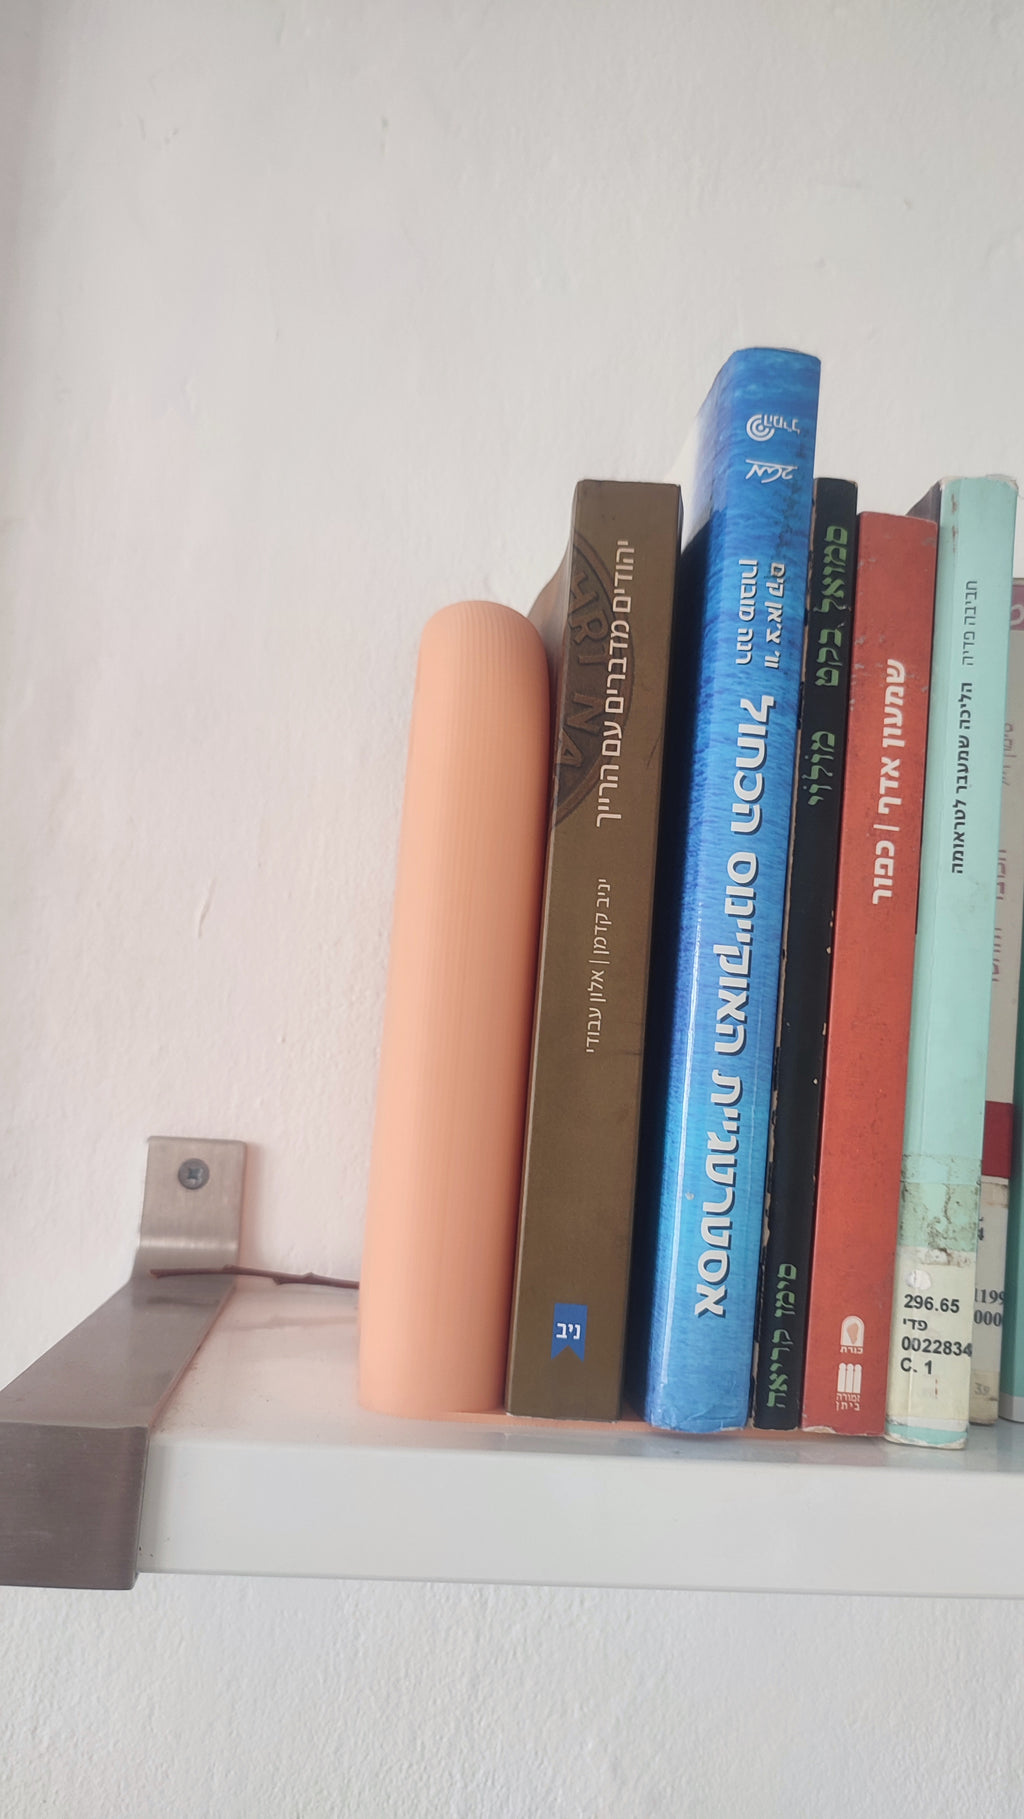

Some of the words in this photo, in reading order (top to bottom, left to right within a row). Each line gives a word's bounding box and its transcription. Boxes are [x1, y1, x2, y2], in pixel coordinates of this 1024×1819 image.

[610, 539, 636, 614] יהודים
[738, 558, 759, 622] מובורן
[765, 561, 787, 598] קים
[812, 524, 849, 614] סמואל
[963, 580, 978, 626] חביבה
[603, 619, 631, 715] מדברים
[735, 627, 755, 666] רנה
[813, 627, 844, 687] בקט
[960, 630, 976, 667] פדיה
[881, 658, 906, 749] שמעון
[956, 682, 973, 731] הליכה
[600, 720, 623, 757] עם
[730, 694, 777, 835] הכחול
[877, 757, 903, 815] אדף
[954, 735, 971, 795] שמעבר
[595, 763, 622, 828] הרייך
[950, 799, 967, 875] לטראומה
[595, 877, 611, 909] יניב
[871, 839, 896, 905] כפור
[591, 912, 613, 956] קדמן
[712, 851, 762, 1057] האוקיינוס
[586, 969, 607, 1003] אלון
[584, 1006, 603, 1054] עבודי
[694, 1068, 748, 1319] אסטרטגיית
[773, 1263, 797, 1318] סימן
[903, 1293, 960, 1314] 296.65
[555, 1322, 581, 1340] ניב
[901, 1335, 973, 1358] 0022834
[902, 1317, 928, 1331] פדי
[765, 1328, 794, 1409] קריאה
[900, 1357, 918, 1373] C.
[924, 1359, 933, 1375] 1
[835, 1402, 861, 1412] ביתן
[836, 1392, 861, 1403] זמורה
